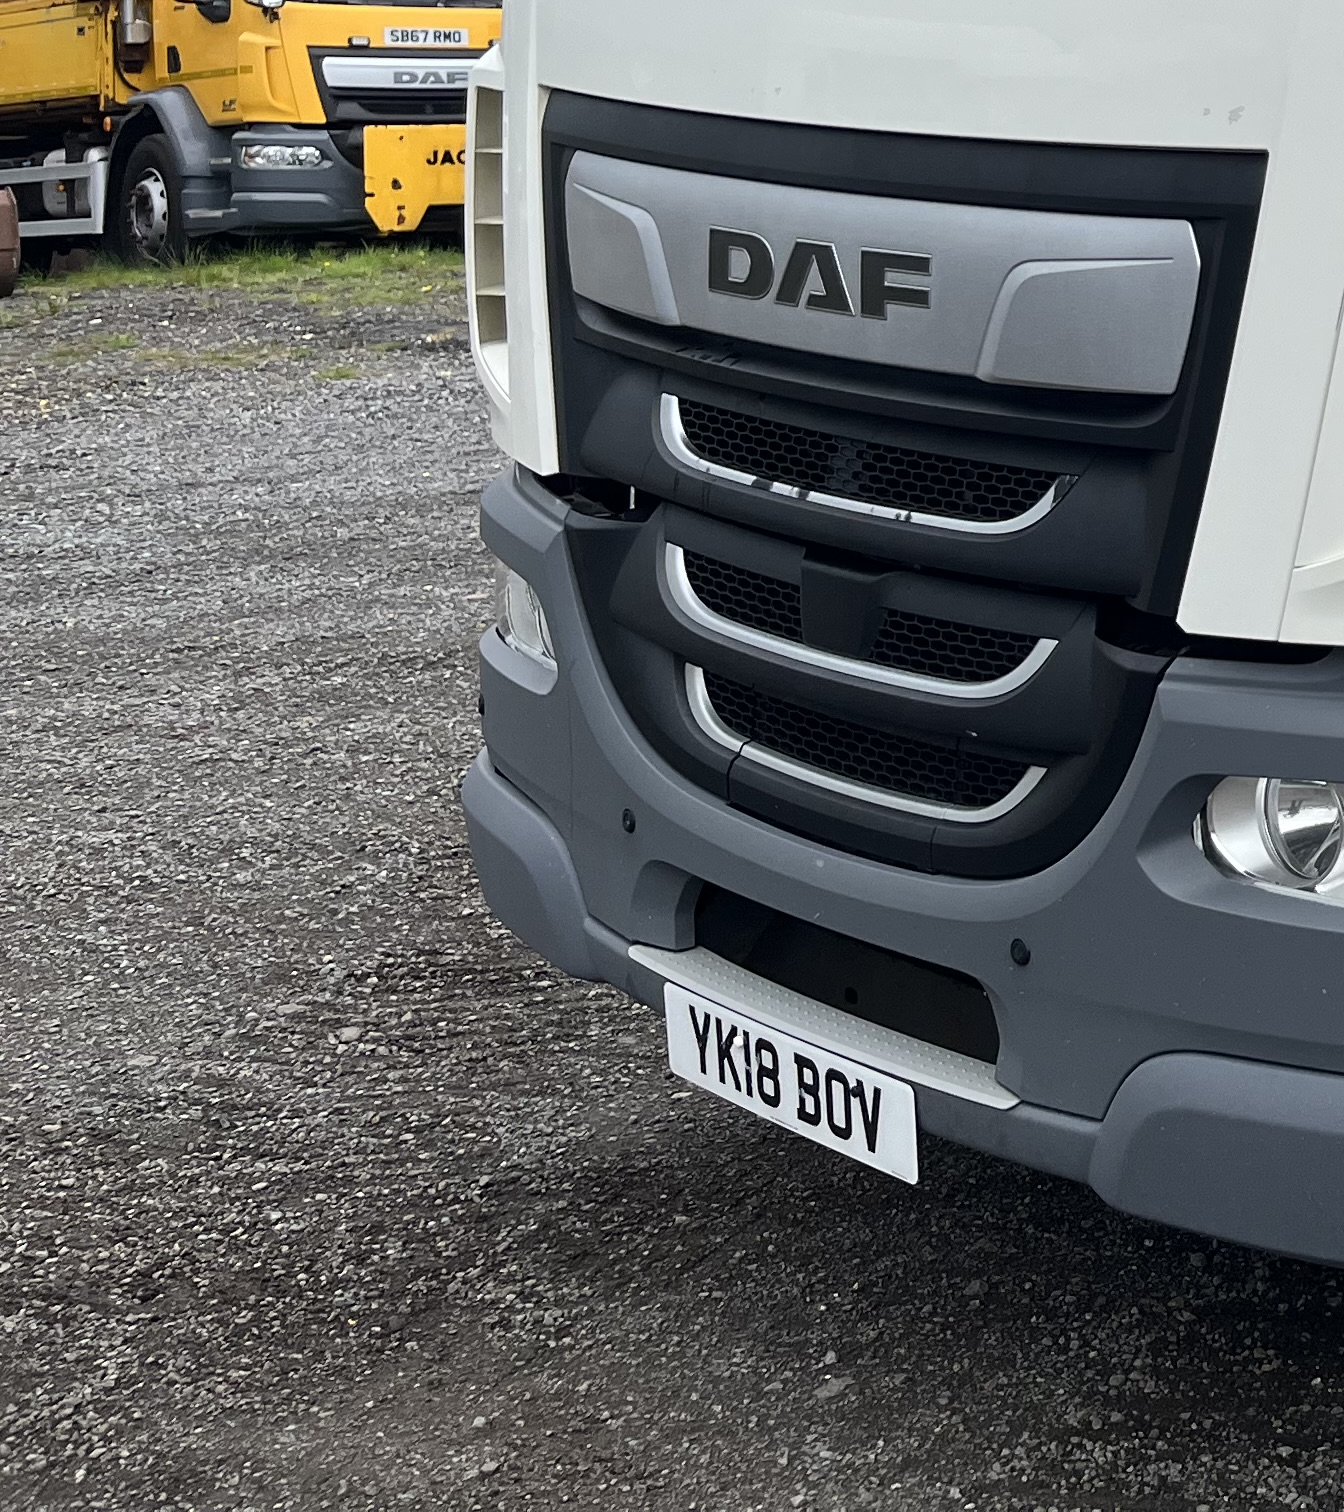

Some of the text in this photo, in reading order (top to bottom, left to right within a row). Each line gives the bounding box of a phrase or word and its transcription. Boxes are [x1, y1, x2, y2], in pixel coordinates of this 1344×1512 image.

[390, 29, 462, 43] SB67 RMO
[393, 71, 469, 84] DAF
[707, 224, 933, 320] DAF
[688, 1004, 882, 1154] YK18 BOV
